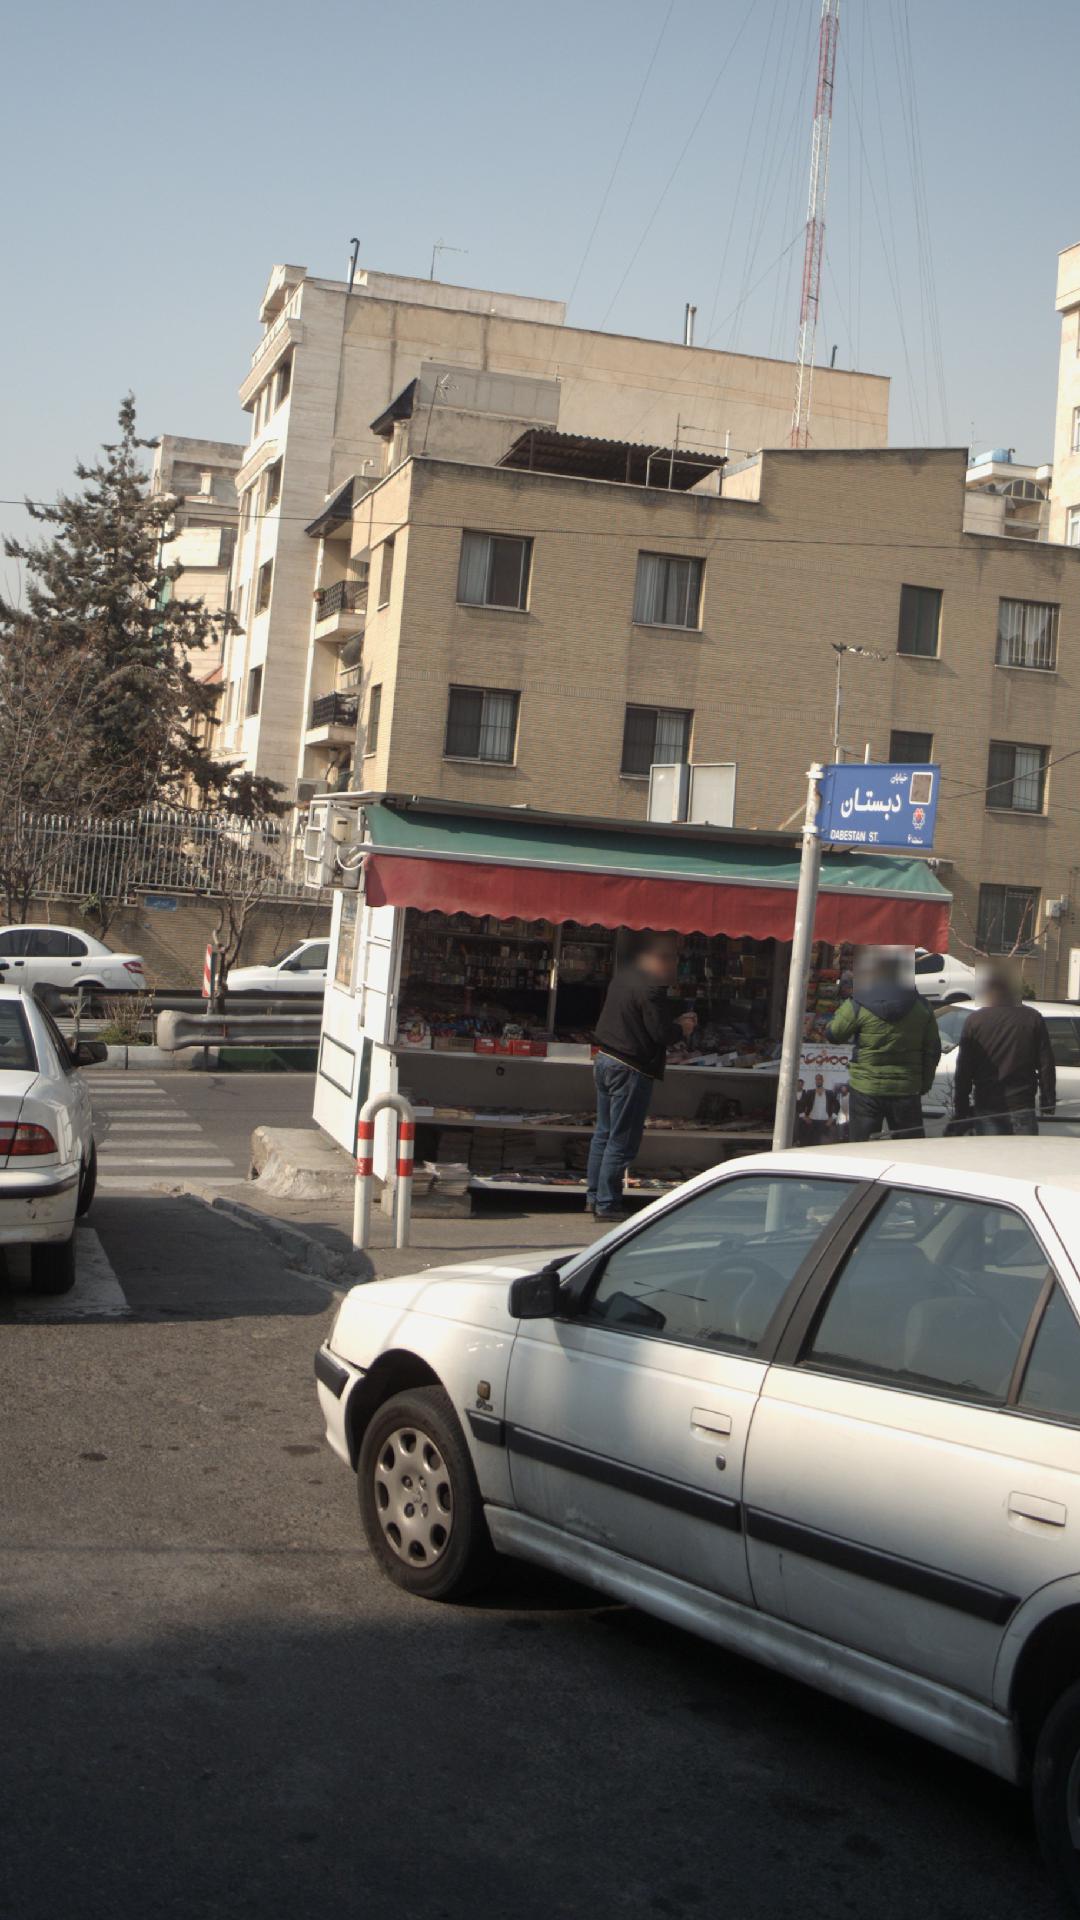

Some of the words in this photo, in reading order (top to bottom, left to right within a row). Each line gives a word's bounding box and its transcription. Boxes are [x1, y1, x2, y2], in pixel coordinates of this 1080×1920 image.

[890, 773, 908, 785] خیابان
[840, 787, 902, 821] دبستان
[830, 829, 866, 842] DABESTAN
[868, 831, 879, 843] ST.
